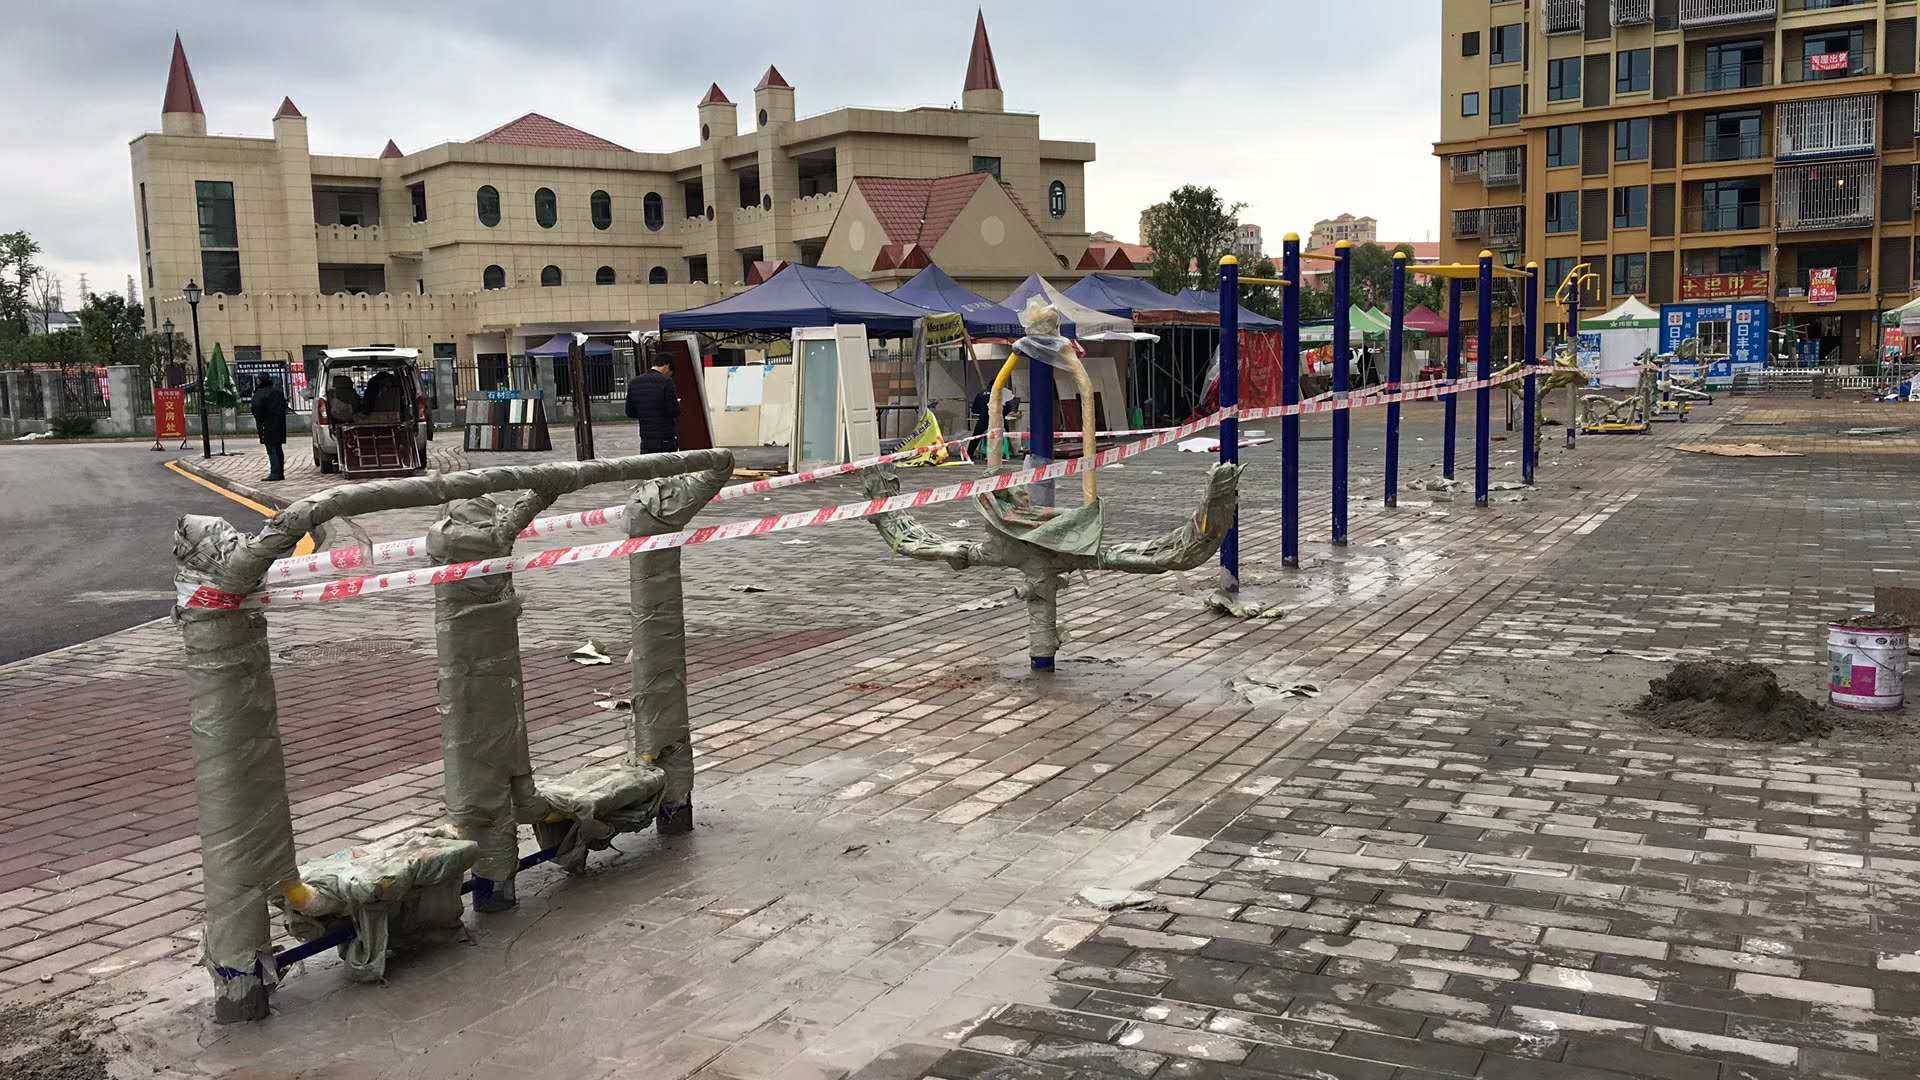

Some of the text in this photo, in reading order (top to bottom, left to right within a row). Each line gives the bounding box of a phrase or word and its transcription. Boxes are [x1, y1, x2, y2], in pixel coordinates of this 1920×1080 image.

[1736, 325, 1750, 361] 日丰管
[164, 400, 176, 431] 交房处
